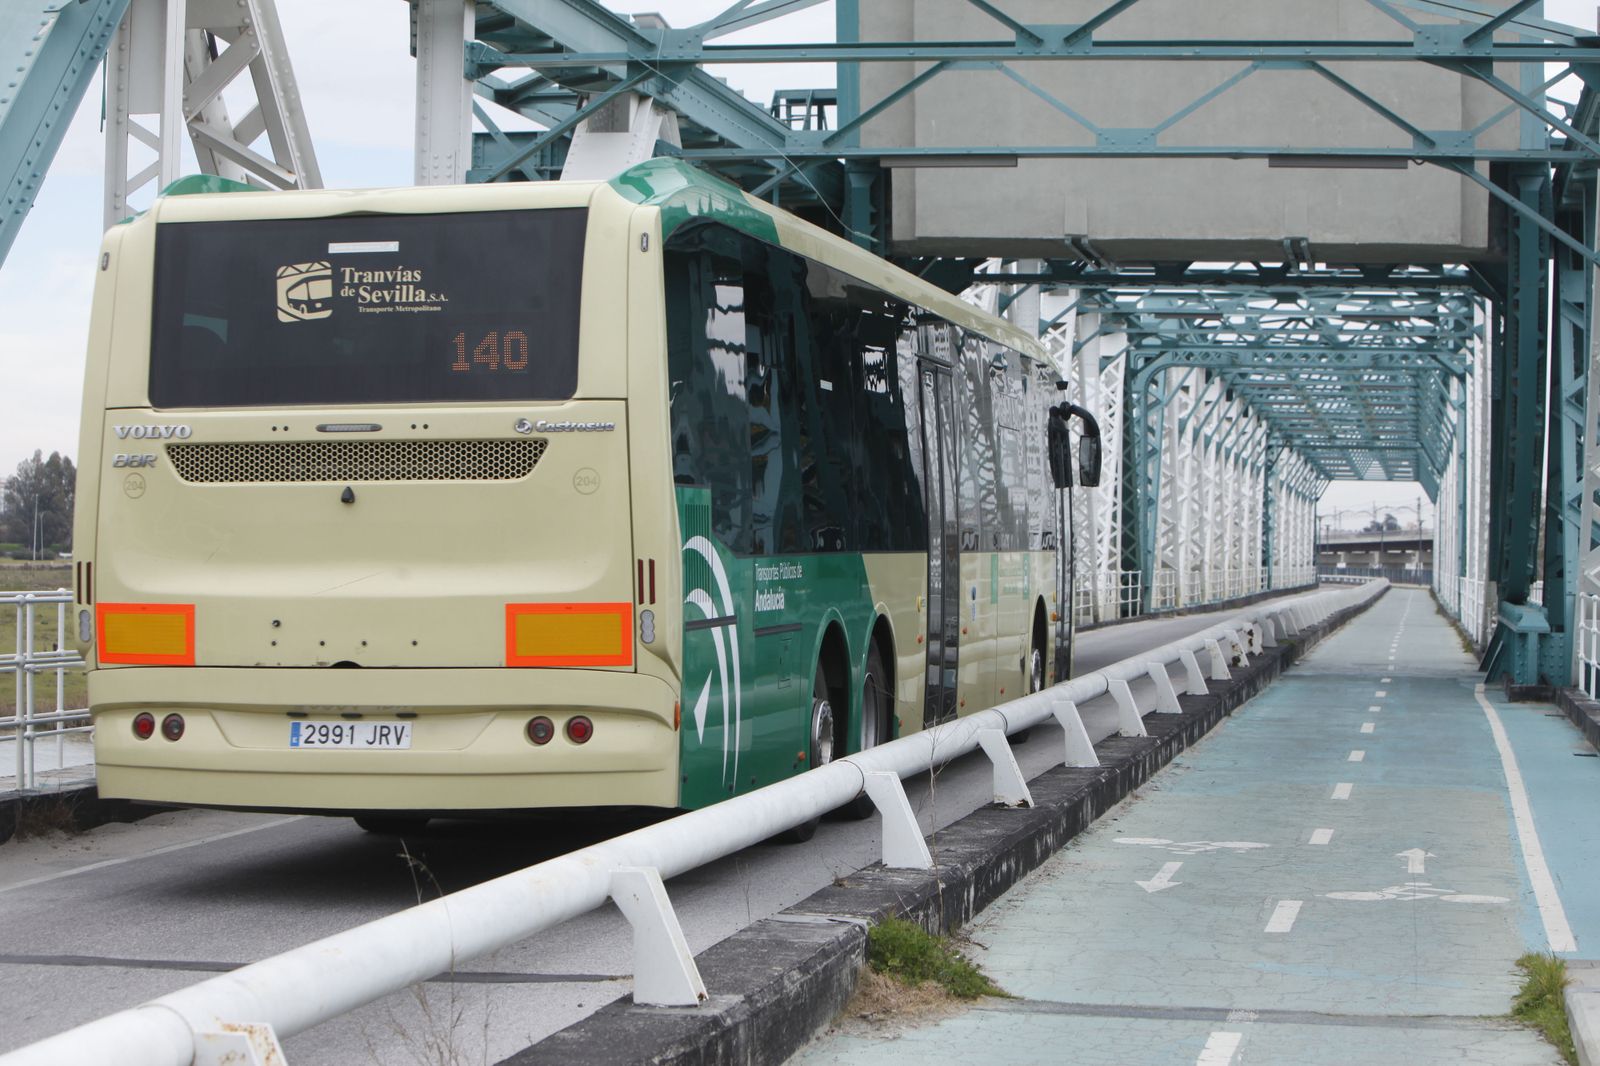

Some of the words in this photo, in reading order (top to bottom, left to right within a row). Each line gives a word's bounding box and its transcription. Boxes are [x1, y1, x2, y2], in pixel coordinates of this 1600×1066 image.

[340, 266, 422, 284] Tranvías
[340, 286, 356, 297] de
[358, 306, 394, 314] Transporte
[395, 304, 442, 314] Metropolitano
[451, 331, 528, 371] 140
[112, 424, 193, 440] VOLVO
[535, 420, 615, 432] Castrosua
[576, 475, 597, 487] 204
[754, 585, 785, 612] Andalucía
[303, 724, 356, 745] 2991
[366, 724, 406, 746] JRV
